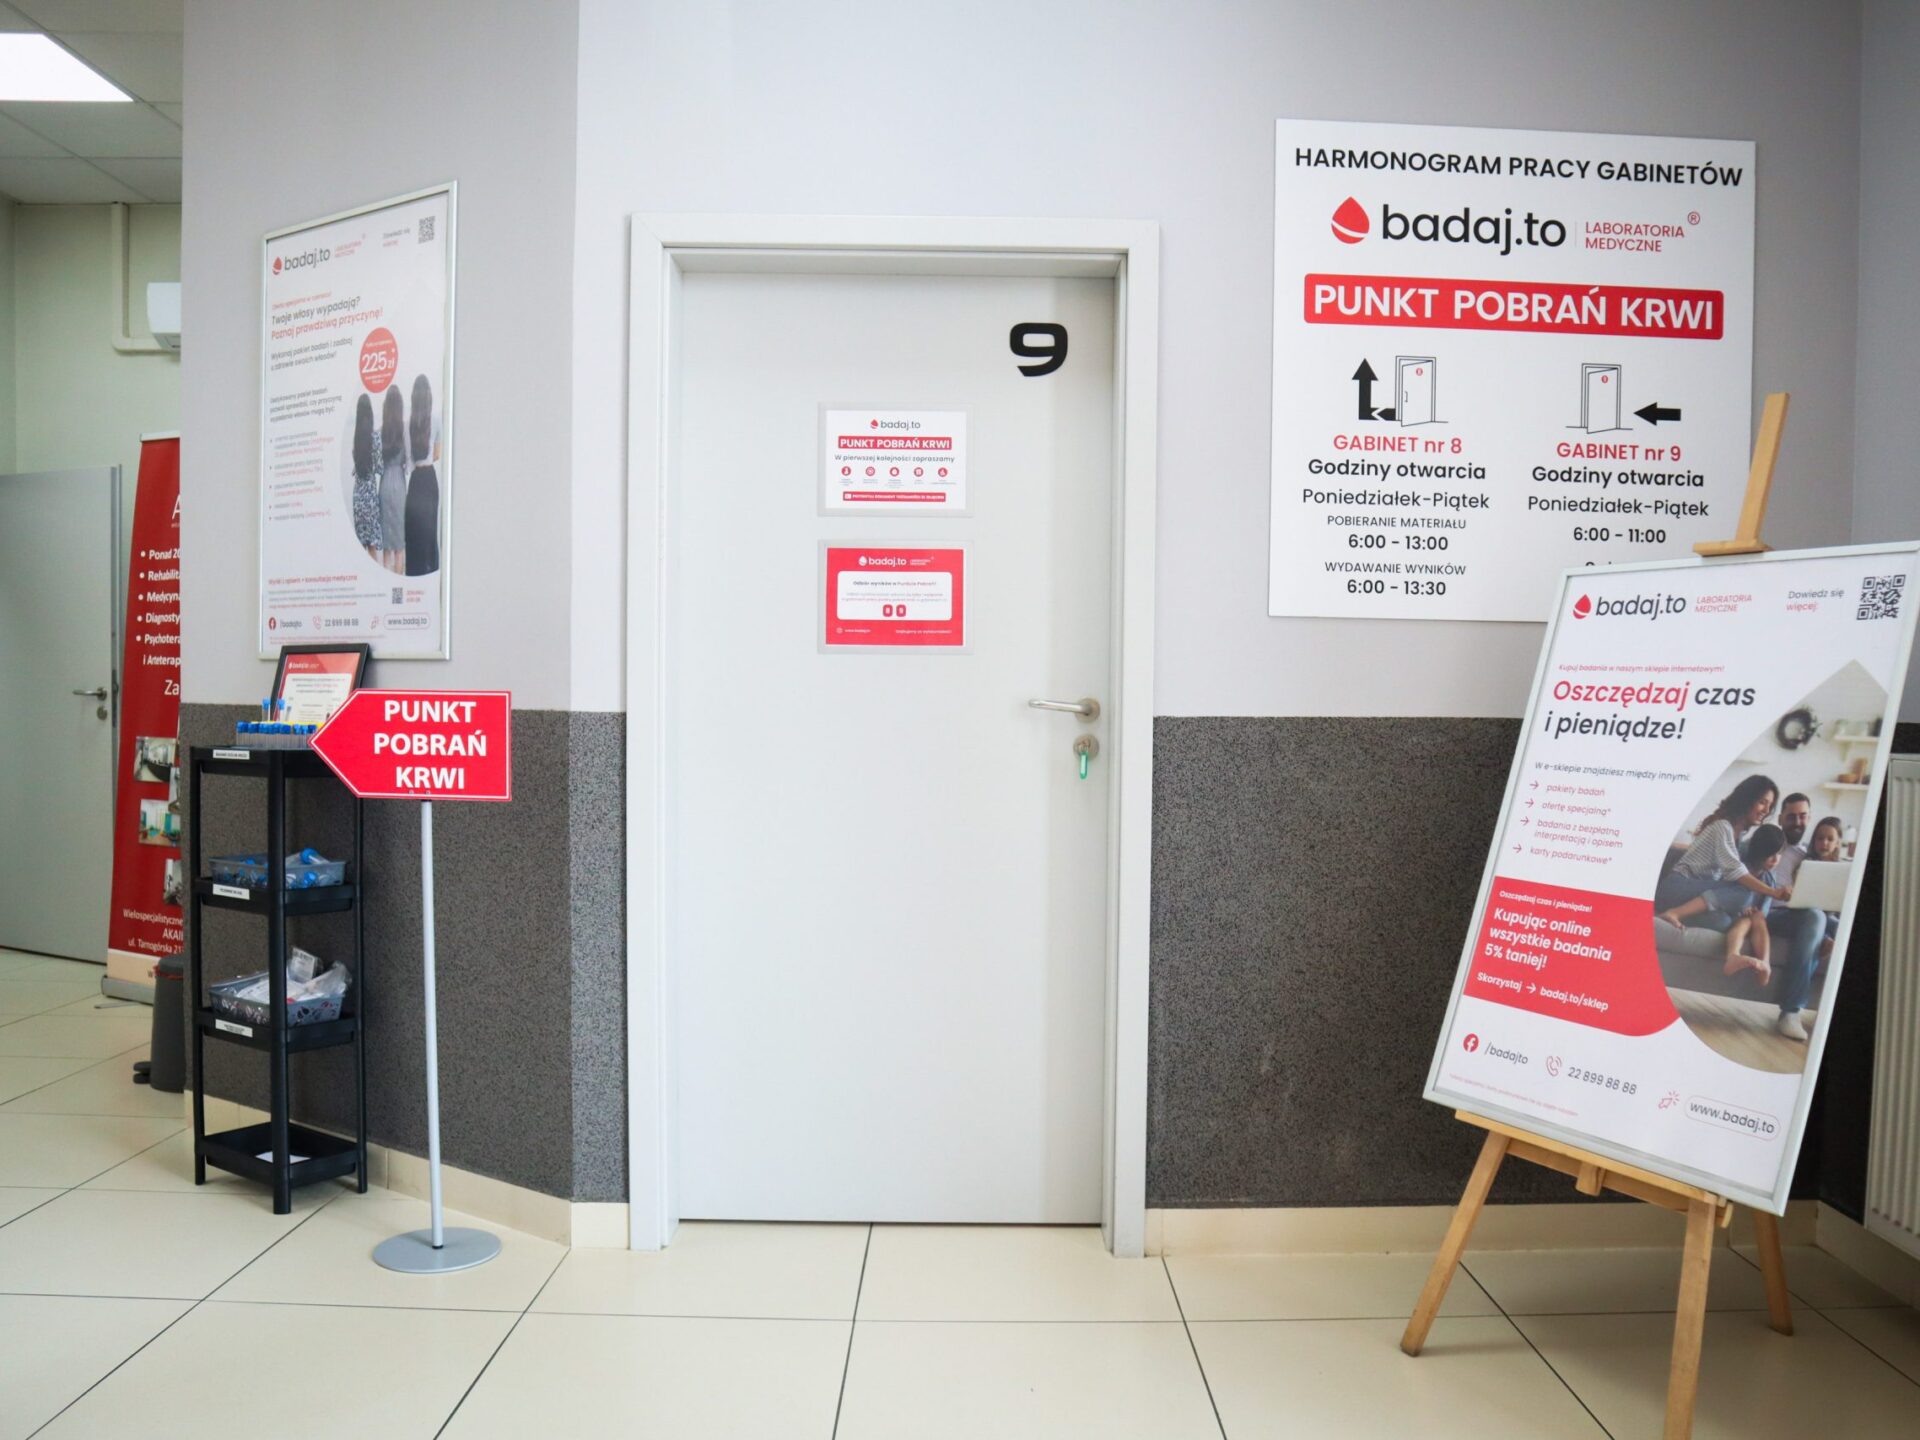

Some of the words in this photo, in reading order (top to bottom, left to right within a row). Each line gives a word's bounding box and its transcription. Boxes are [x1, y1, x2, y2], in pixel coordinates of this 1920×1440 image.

[1295, 148, 1501, 175] HARMONOGRAM
[1508, 156, 1590, 180] PRACY
[1597, 160, 1743, 187] GABINETÓW
[1382, 204, 1567, 256] badaj.to
[1585, 221, 1684, 238] LABORATORIA
[1585, 237, 1662, 252] MEDYCZNE
[284, 248, 331, 270] badaj.to
[1313, 284, 1439, 318] PUNKT
[1454, 287, 1607, 325] POBRAŃ
[1620, 298, 1714, 330] KRWI
[272, 312, 292, 326] Twoje
[1009, 322, 1068, 377] 9
[362, 351, 387, 374] 225
[880, 420, 921, 431] badaj.to
[840, 439, 875, 448] PUNKT
[877, 437, 921, 448] POBRAŃ
[922, 440, 950, 449] KRWI
[1333, 434, 1419, 453] GABINET
[1424, 439, 1445, 453] nr
[1450, 438, 1462, 454] 8
[1556, 442, 1639, 460] GABINET
[1644, 447, 1665, 462] nr
[1669, 445, 1682, 462] 9
[1308, 458, 1391, 482] Godziny
[1396, 461, 1486, 480] otwarcia
[1531, 465, 1613, 489] Godziny
[1618, 469, 1704, 488] otwarcia
[1302, 489, 1490, 511] Poniedziałek-Piątek
[1527, 496, 1709, 518] Poniedziałek-Piątek
[1327, 515, 1397, 528] POBIERANIE
[1400, 517, 1466, 530] MATERIAŁU
[1348, 535, 1387, 551] 6:00
[1405, 536, 1449, 552] 13:00
[1573, 527, 1610, 543] 6:00
[1628, 529, 1667, 544] 11:00
[149, 549, 172, 560] Ponad
[868, 556, 907, 567] badaj.to
[1324, 562, 1401, 574] WYDAWANIE
[1405, 561, 1467, 576] WYNIKÓW
[1347, 580, 1386, 596] 6:00
[1404, 580, 1447, 597] 13:30
[1788, 589, 1828, 600] Dowiedz
[1830, 588, 1845, 600] się
[1596, 593, 1687, 621] badaj.to
[1696, 594, 1753, 604] LABORATORIA
[1695, 603, 1739, 613] MEDYCZNE
[1559, 663, 1578, 673] Kupuj
[1579, 664, 1609, 672] badania
[1616, 666, 1644, 675] naszym
[1645, 664, 1669, 674] sklepie
[1553, 680, 1690, 711] Oszczędzaj
[1694, 686, 1756, 706] czas
[384, 700, 477, 723] PUNKT
[1545, 711, 1553, 732] i
[1555, 712, 1686, 742] pieniądze!
[374, 730, 487, 756] POBRAŃ
[396, 767, 465, 789] KRWI
[1544, 763, 1581, 774] e-sklepie
[1583, 767, 1624, 778] znajdziesz
[1626, 769, 1657, 780] między
[1546, 783, 1576, 796] pakiety
[1577, 786, 1605, 796] badań
[1542, 801, 1565, 812] ofertę
[1537, 819, 1572, 831] badania
[1578, 823, 1620, 836] bezpłatną
[1534, 830, 1586, 845] interpretacją
[1592, 839, 1623, 849] opisem
[1530, 847, 1550, 858] karty
[1499, 890, 1536, 906] Oszczędzaj
[1536, 897, 1552, 906] czas
[1494, 908, 1547, 930] Kupując
[1550, 919, 1591, 937] online
[1489, 926, 1551, 949] wszystkie
[1553, 939, 1612, 961] badania
[1484, 943, 1503, 959] 5%
[1505, 948, 1548, 971] taniej!
[1477, 972, 1522, 993] Skorzystaj
[1540, 986, 1609, 1012] badaj.to/sklep
[1484, 1043, 1528, 1065] /badajto
[1568, 1066, 1583, 1080] 22
[1584, 1070, 1604, 1086] 899
[1605, 1077, 1620, 1091] 88
[1622, 1081, 1638, 1096] 88
[1689, 1101, 1775, 1134] www.badaj.to
